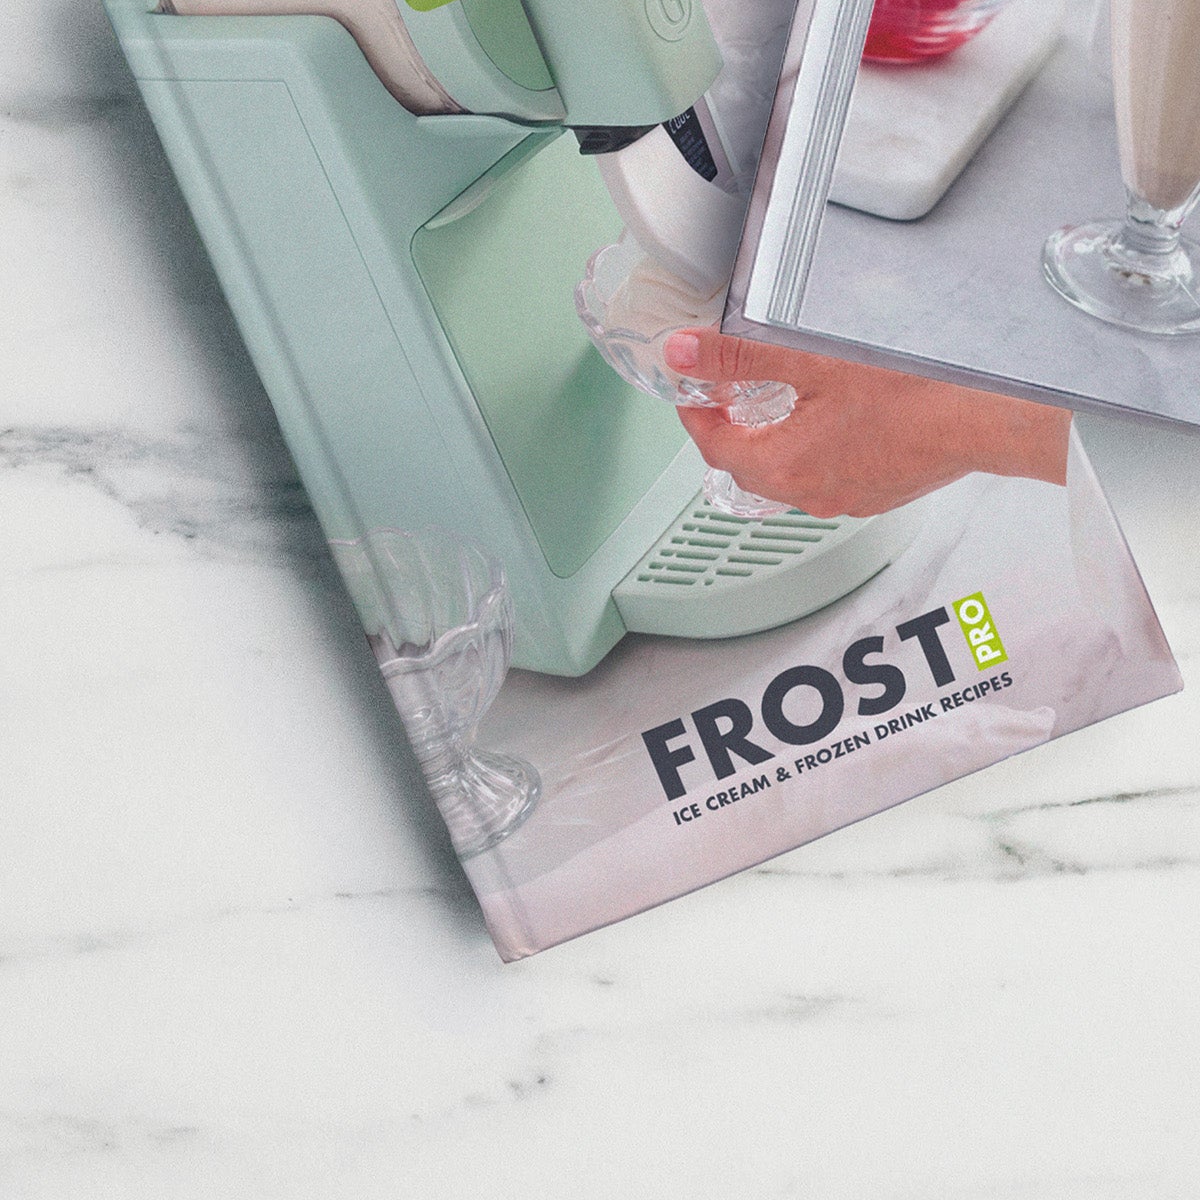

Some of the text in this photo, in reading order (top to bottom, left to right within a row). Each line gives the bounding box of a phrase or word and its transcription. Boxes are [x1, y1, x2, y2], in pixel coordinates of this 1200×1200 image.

[641, 606, 956, 802] FROST
[958, 598, 1003, 665] PRO
[673, 671, 1013, 826] ICE CREAM & FROZEN DRINK RECIPES
